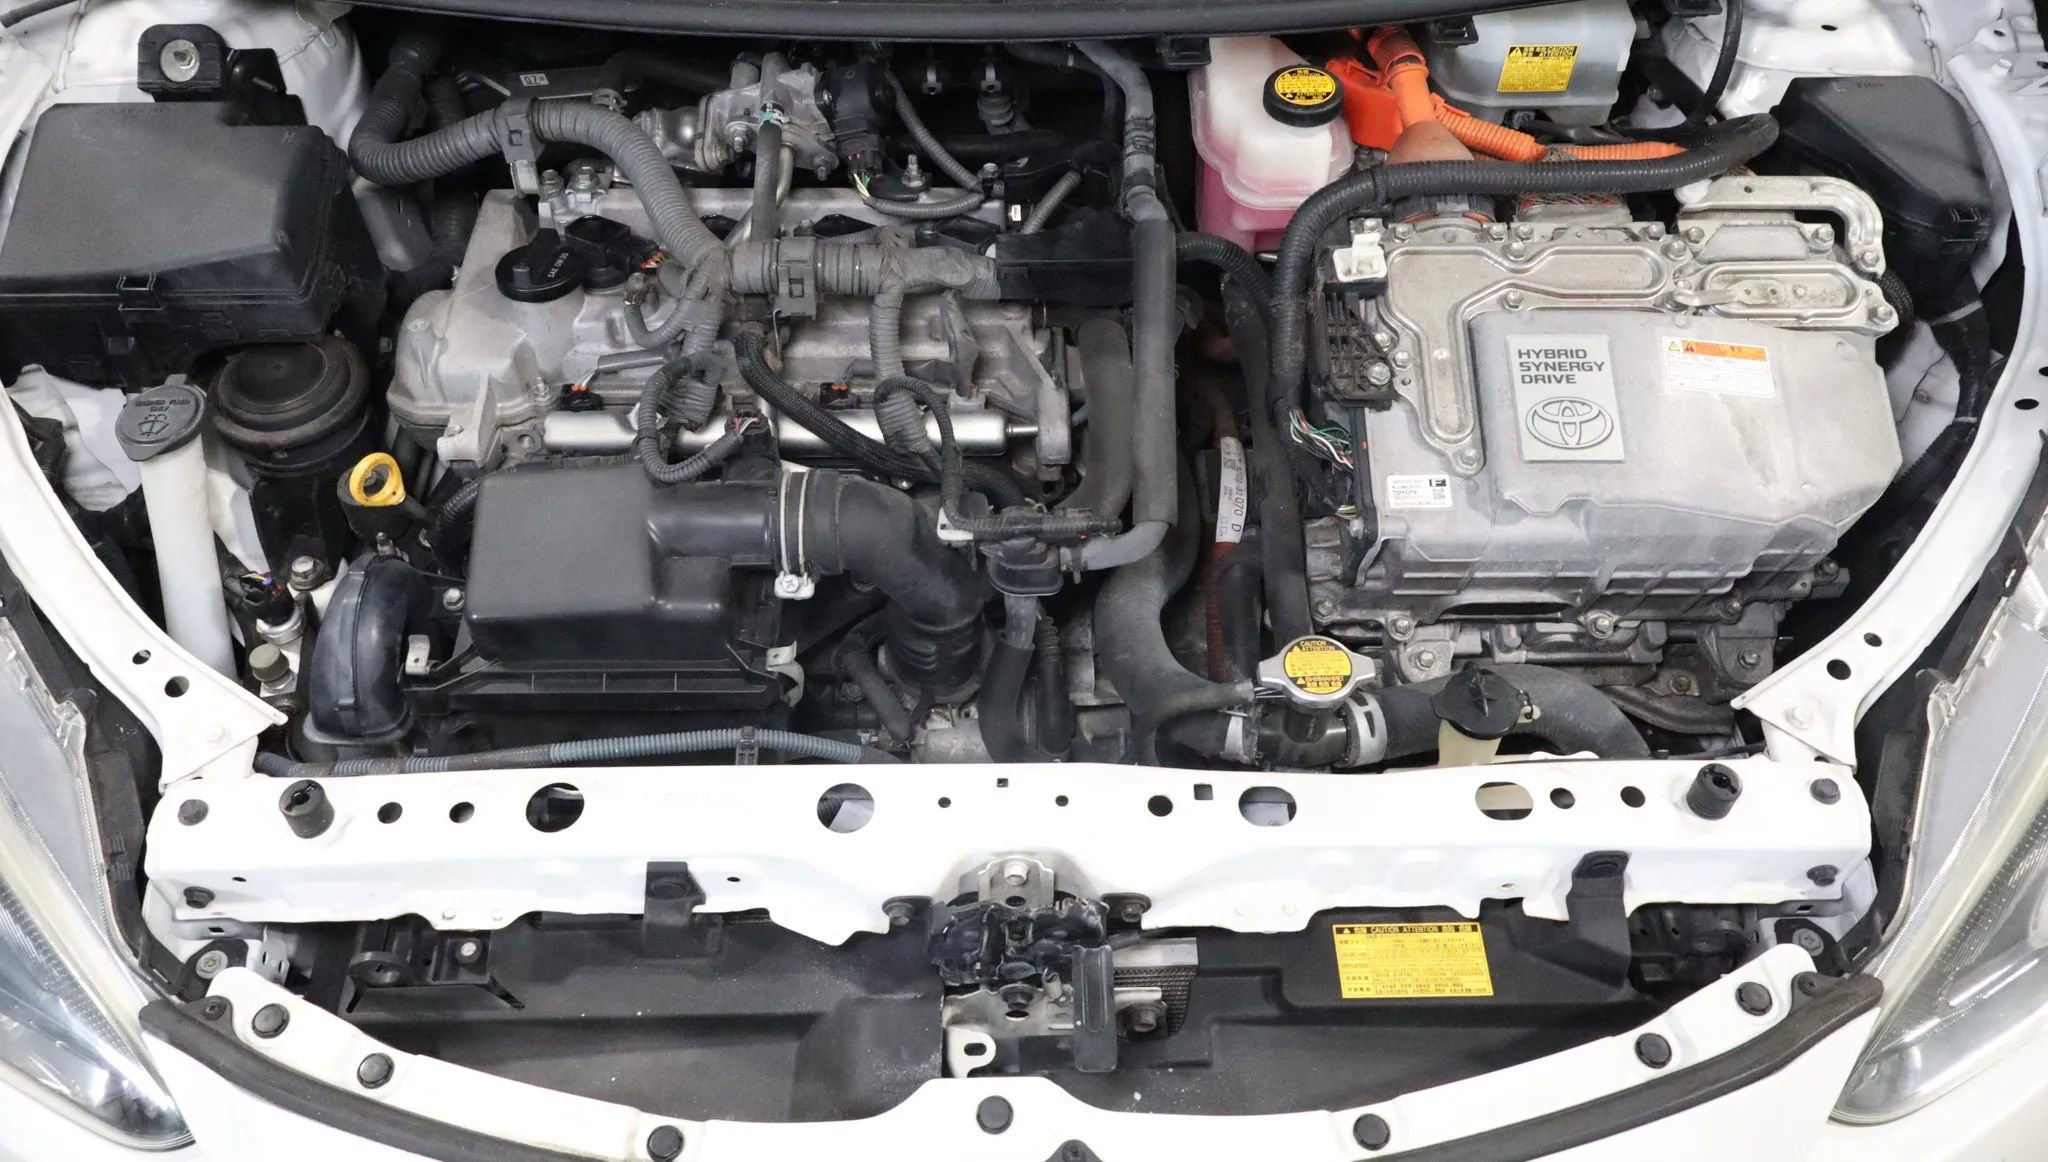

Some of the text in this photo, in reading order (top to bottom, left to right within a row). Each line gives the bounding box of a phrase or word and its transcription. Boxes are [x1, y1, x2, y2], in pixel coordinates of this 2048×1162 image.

[1518, 349, 1587, 359] HYBRID
[1519, 361, 1605, 372] SYNERGY
[1521, 374, 1577, 384] DRIVE
[1231, 523, 1242, 533] D
[1370, 926, 1399, 934] CAUTION
[1402, 925, 1439, 933] ATTENTION
